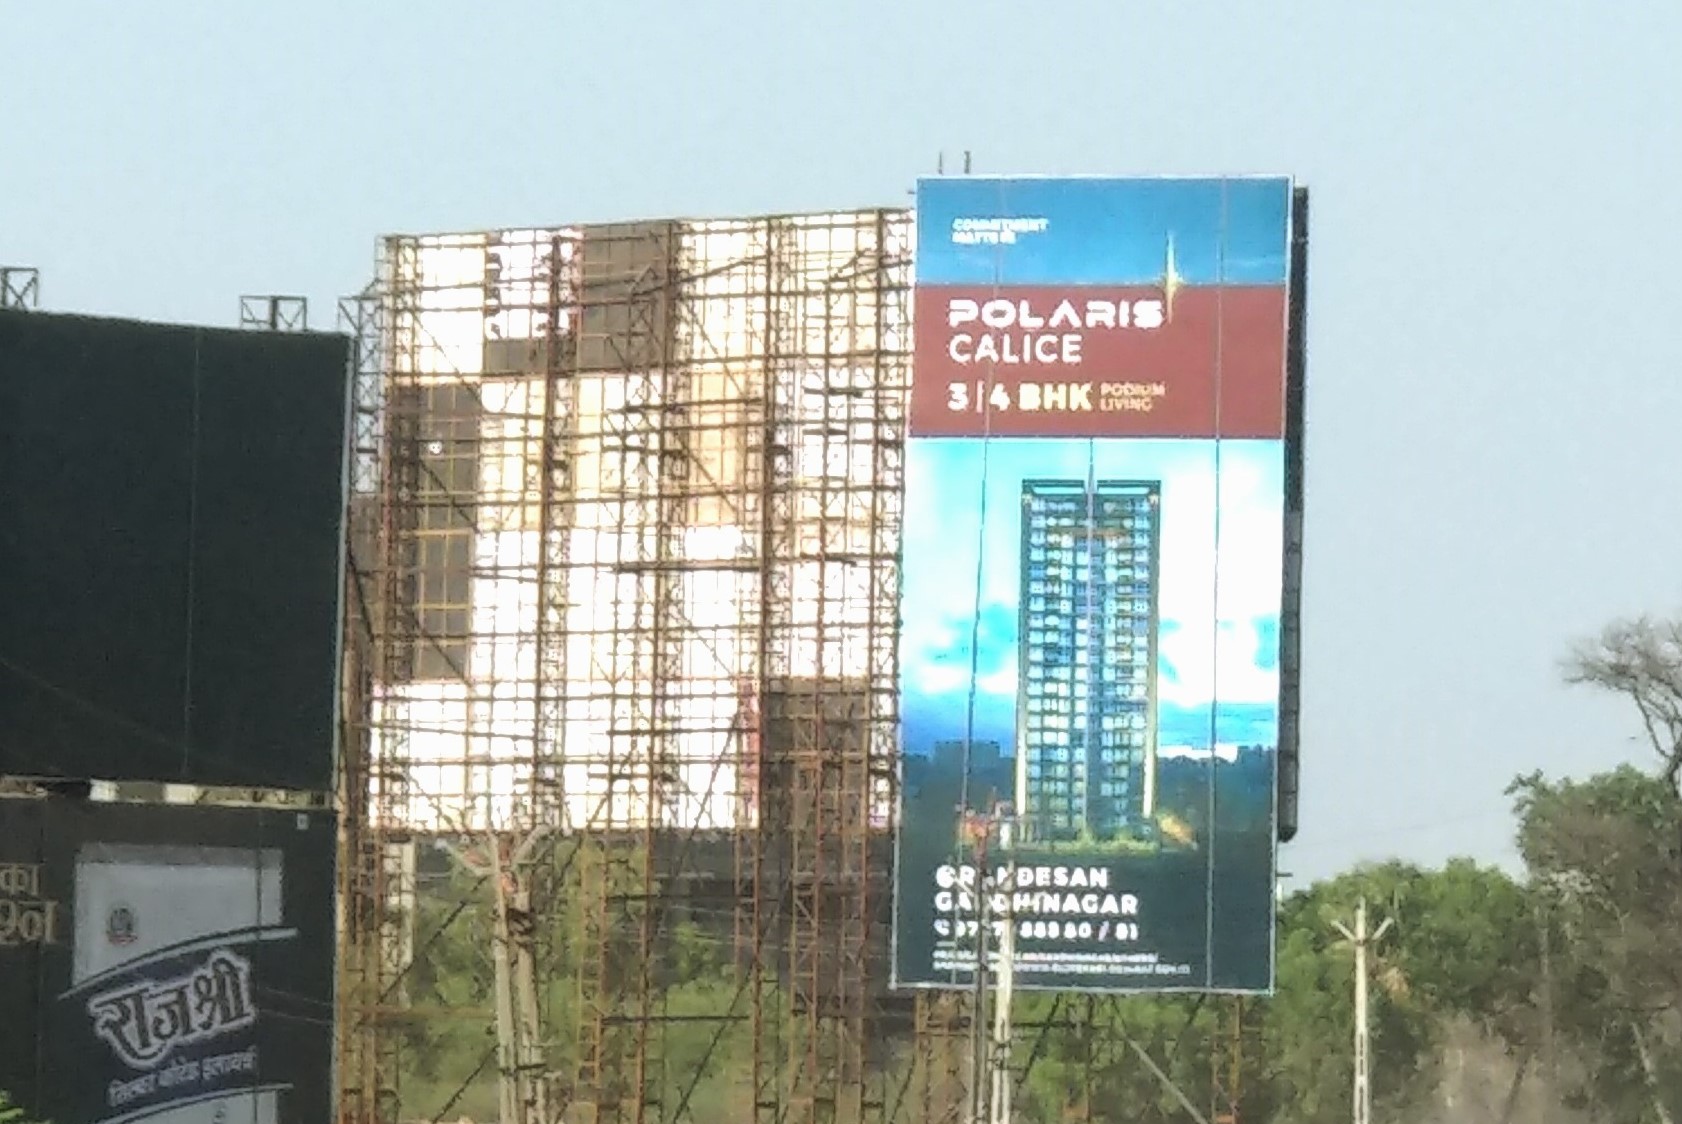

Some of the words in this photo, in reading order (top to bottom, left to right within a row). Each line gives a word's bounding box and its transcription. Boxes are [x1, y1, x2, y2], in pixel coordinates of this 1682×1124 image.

[949, 299, 1163, 328] POLARIS
[949, 333, 1082, 364] CALICE
[1019, 382, 1093, 411] BHK
[1100, 383, 1165, 396] PODIUM
[94, 955, 252, 1061] राजश्री
